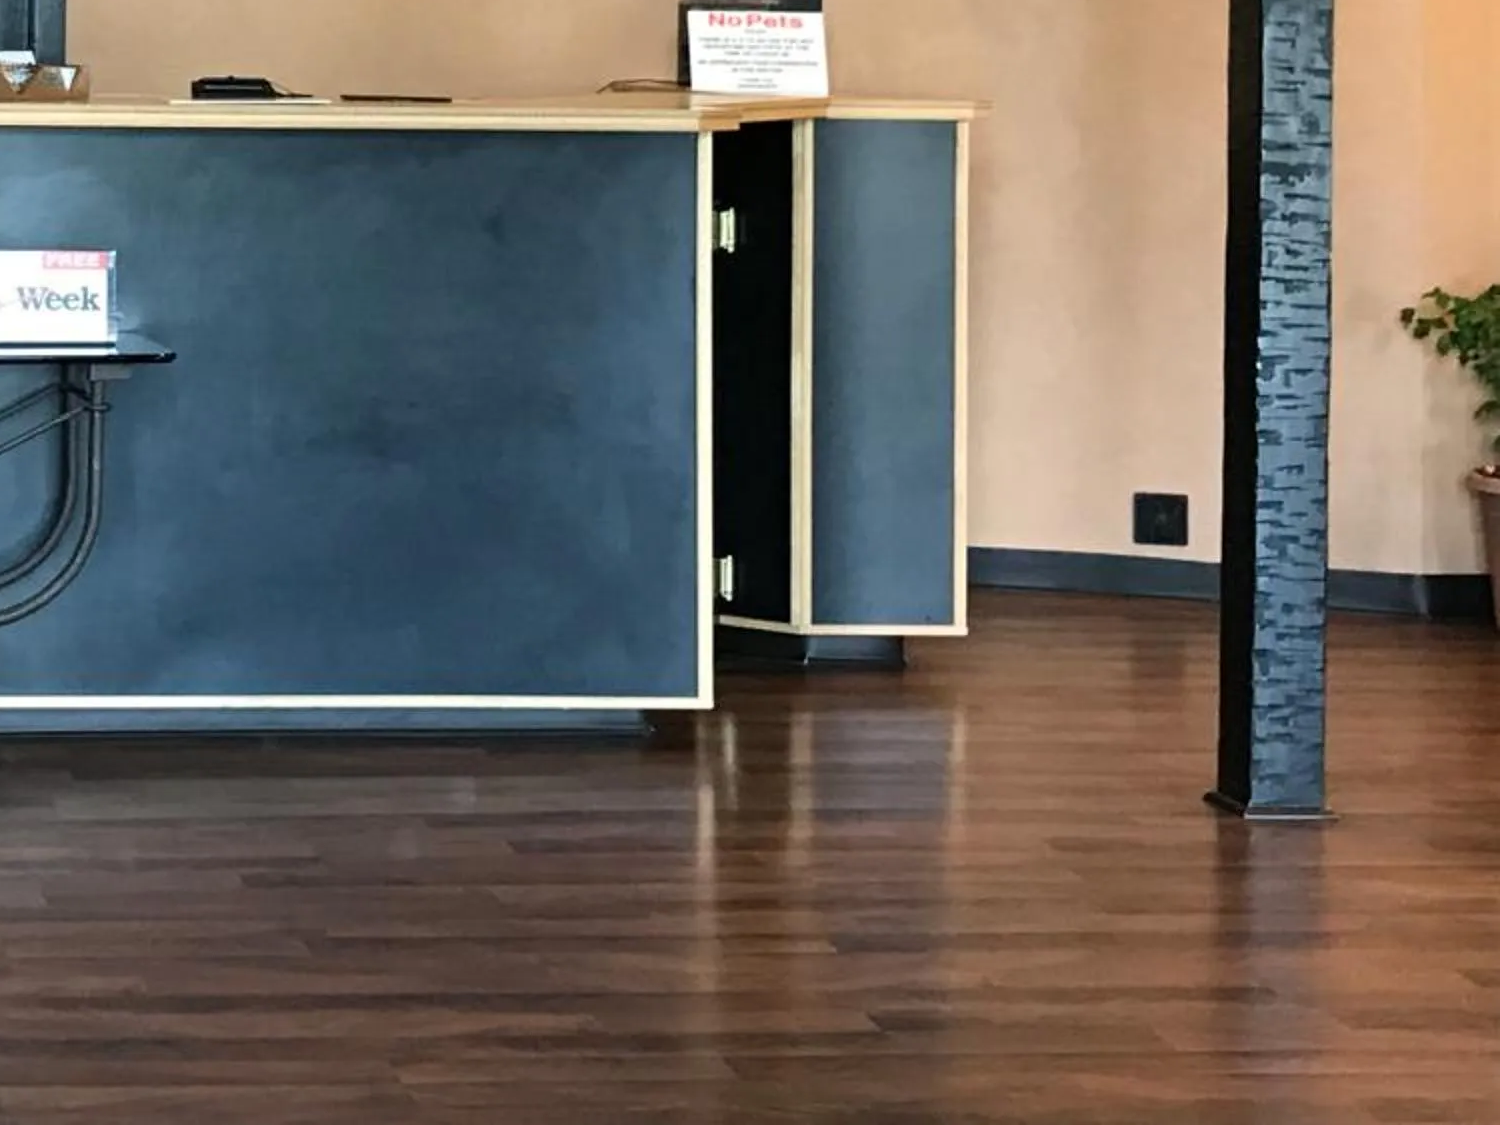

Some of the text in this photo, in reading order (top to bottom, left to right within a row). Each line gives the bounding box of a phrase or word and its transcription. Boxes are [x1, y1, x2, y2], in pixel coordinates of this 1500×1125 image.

[708, 12, 804, 29] No Pets
[16, 286, 101, 312] Week
